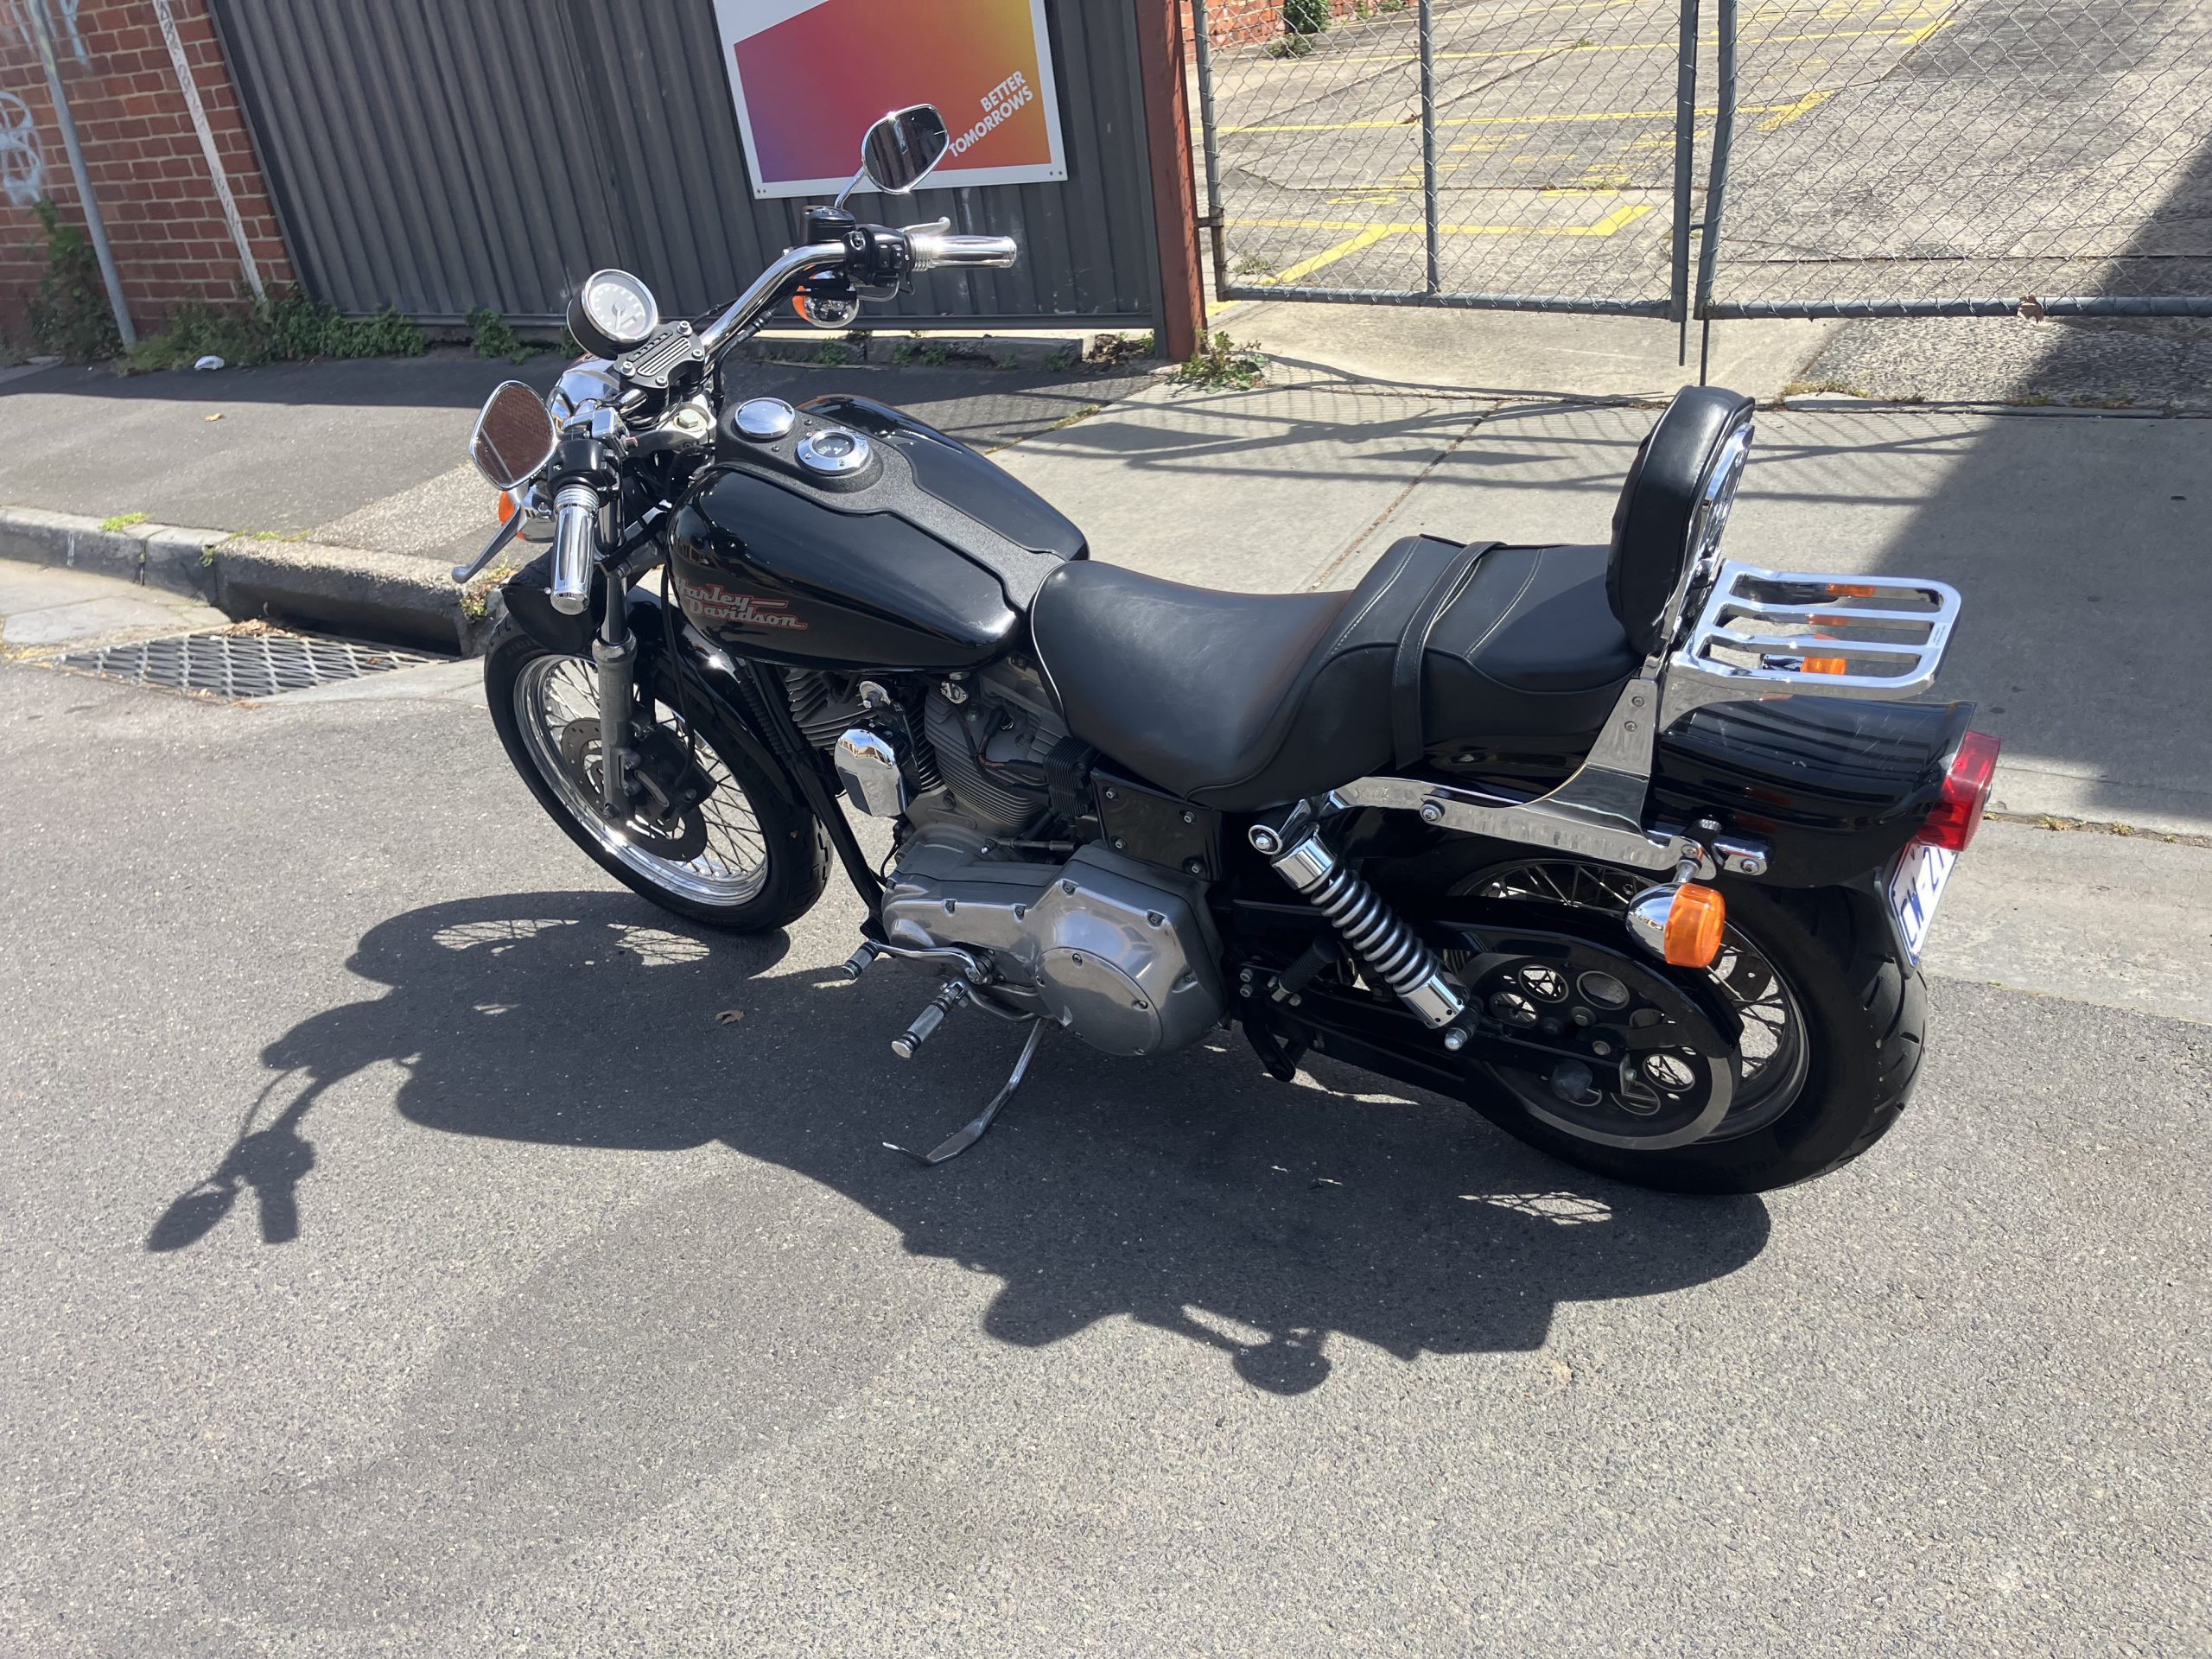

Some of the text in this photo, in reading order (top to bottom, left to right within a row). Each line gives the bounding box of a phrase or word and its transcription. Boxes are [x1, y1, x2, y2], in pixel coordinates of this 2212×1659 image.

[980, 70, 1027, 112] BETTER
[948, 85, 1033, 157] TOMORROWS
[686, 594, 807, 628] Davidson
